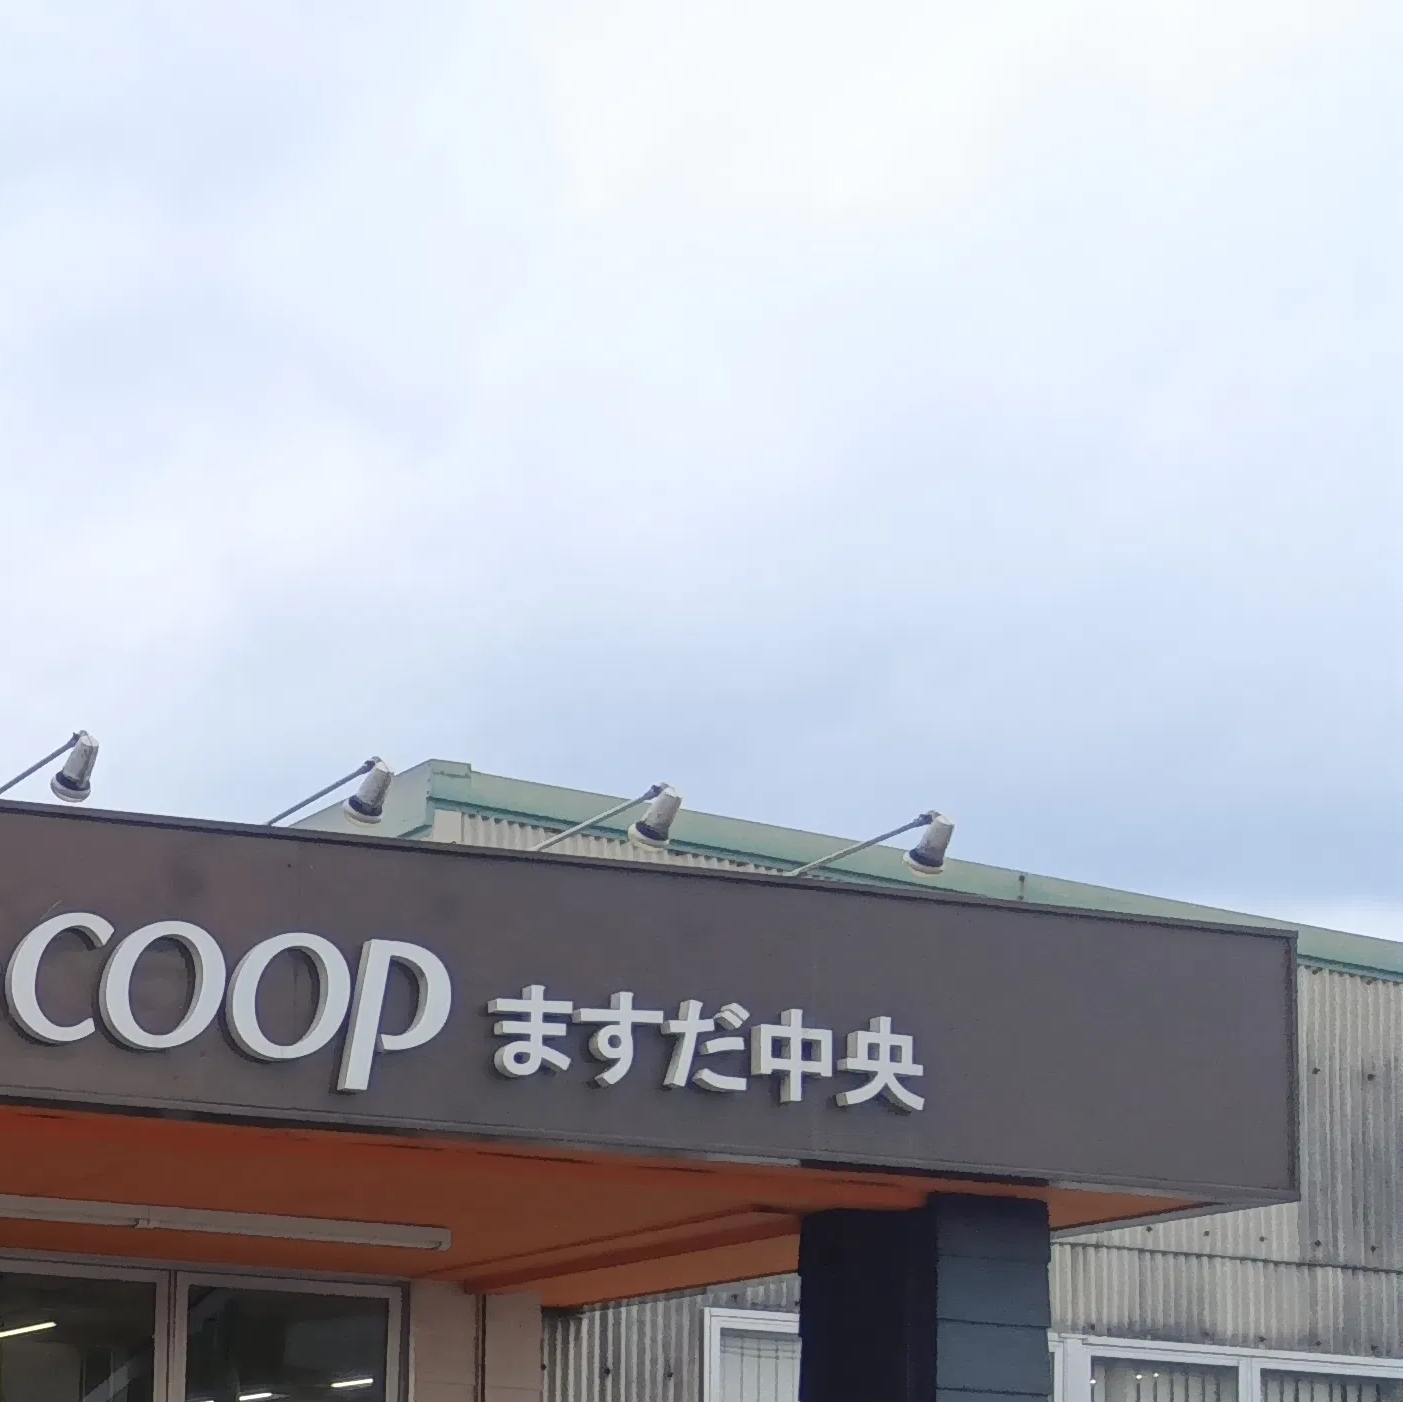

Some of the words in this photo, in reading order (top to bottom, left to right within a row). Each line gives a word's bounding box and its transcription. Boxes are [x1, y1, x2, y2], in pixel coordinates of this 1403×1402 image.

[487, 983, 925, 1113] ますだ中央
